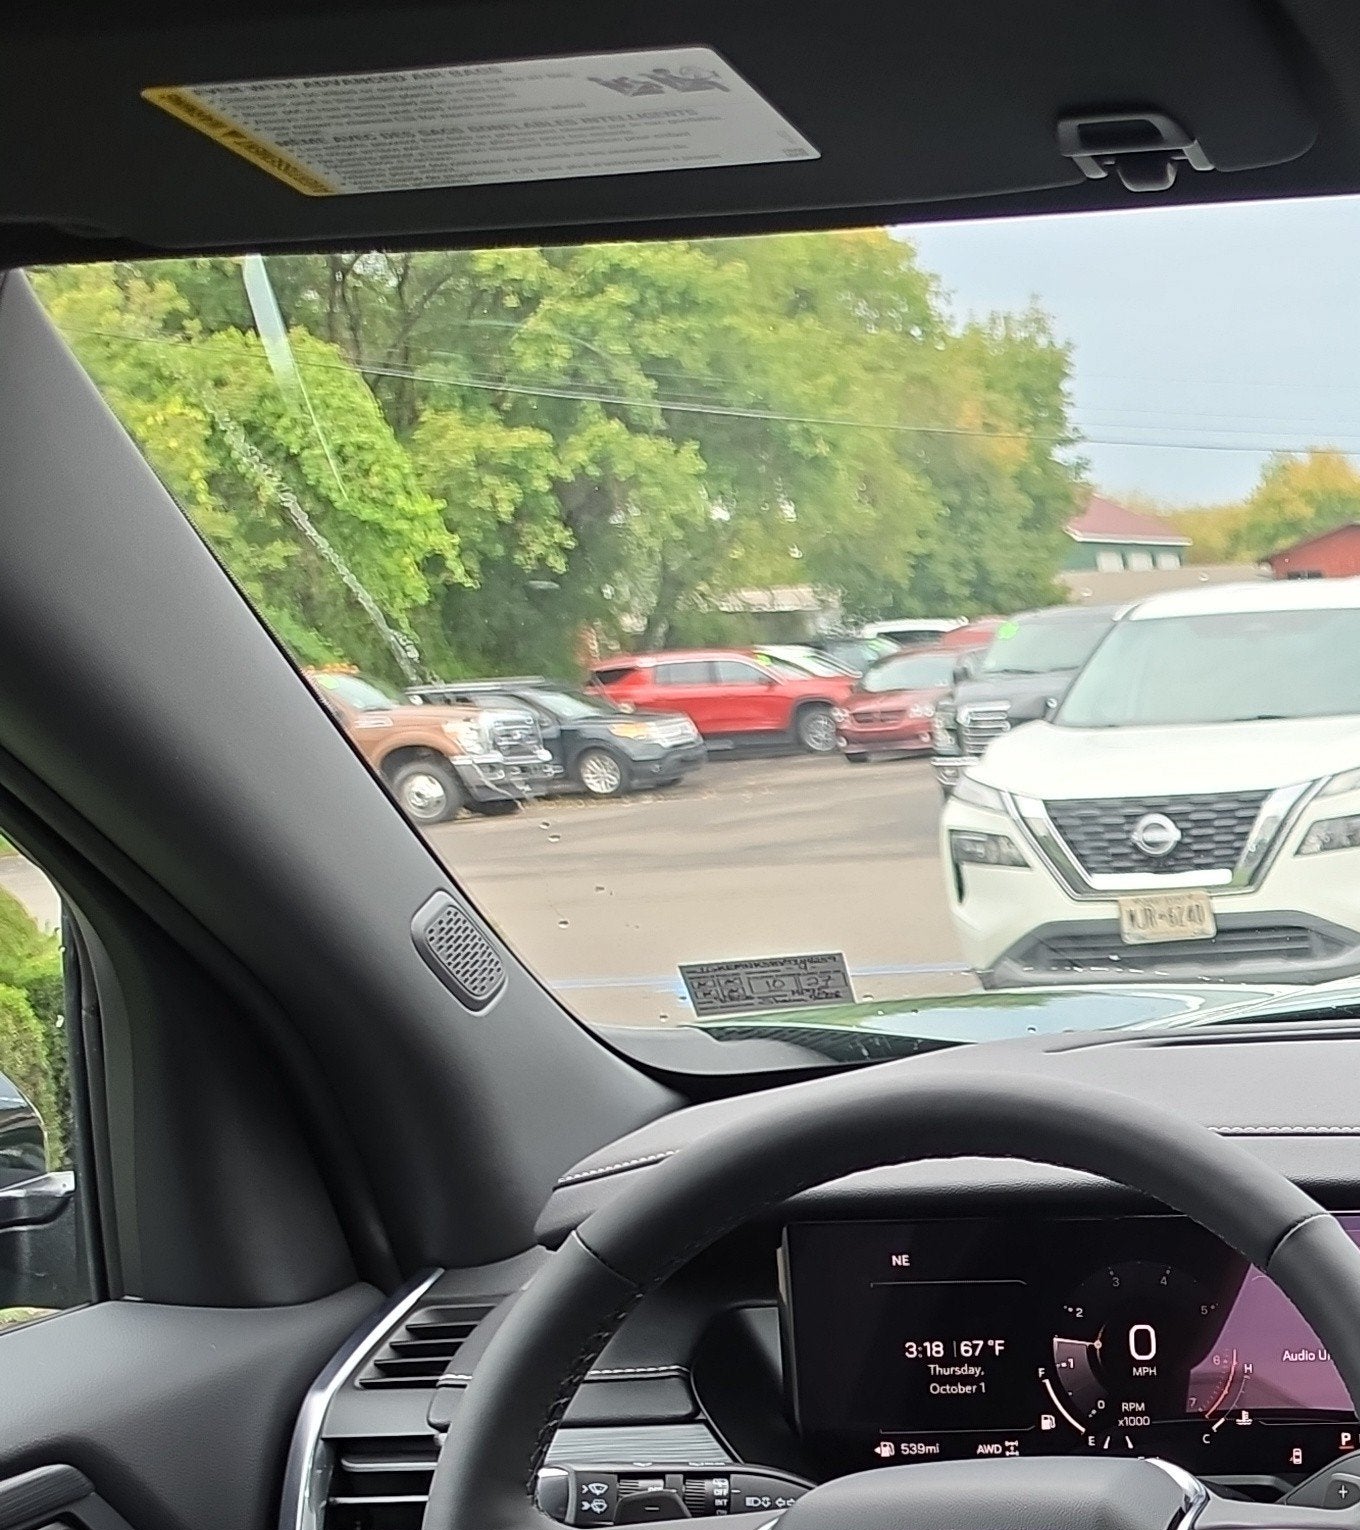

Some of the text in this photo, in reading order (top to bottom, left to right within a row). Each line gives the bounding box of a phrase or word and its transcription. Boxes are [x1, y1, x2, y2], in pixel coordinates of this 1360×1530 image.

[891, 1254, 911, 1267] NE
[1112, 1276, 1121, 1287] 3
[1160, 1276, 1168, 1286] 4
[1075, 1307, 1084, 1318] 2
[1200, 1305, 1208, 1315] 5
[1129, 1324, 1157, 1361] 0
[904, 1341, 945, 1359] 3:18
[960, 1340, 984, 1358] 67
[1282, 1349, 1316, 1362] Audio
[1067, 1358, 1075, 1369] 1
[1244, 1363, 1253, 1374] H
[928, 1364, 985, 1378] Thursday,
[1038, 1367, 1046, 1379] F
[1132, 1366, 1157, 1377] MPH
[929, 1382, 986, 1395] October 1
[1097, 1400, 1106, 1410] 0
[1121, 1402, 1146, 1413] RPM
[1118, 1416, 1151, 1427] x1000
[1088, 1436, 1096, 1446] E
[1202, 1434, 1211, 1444] C
[1340, 1432, 1351, 1446] P
[900, 1442, 1003, 1455] 539mi AWD
